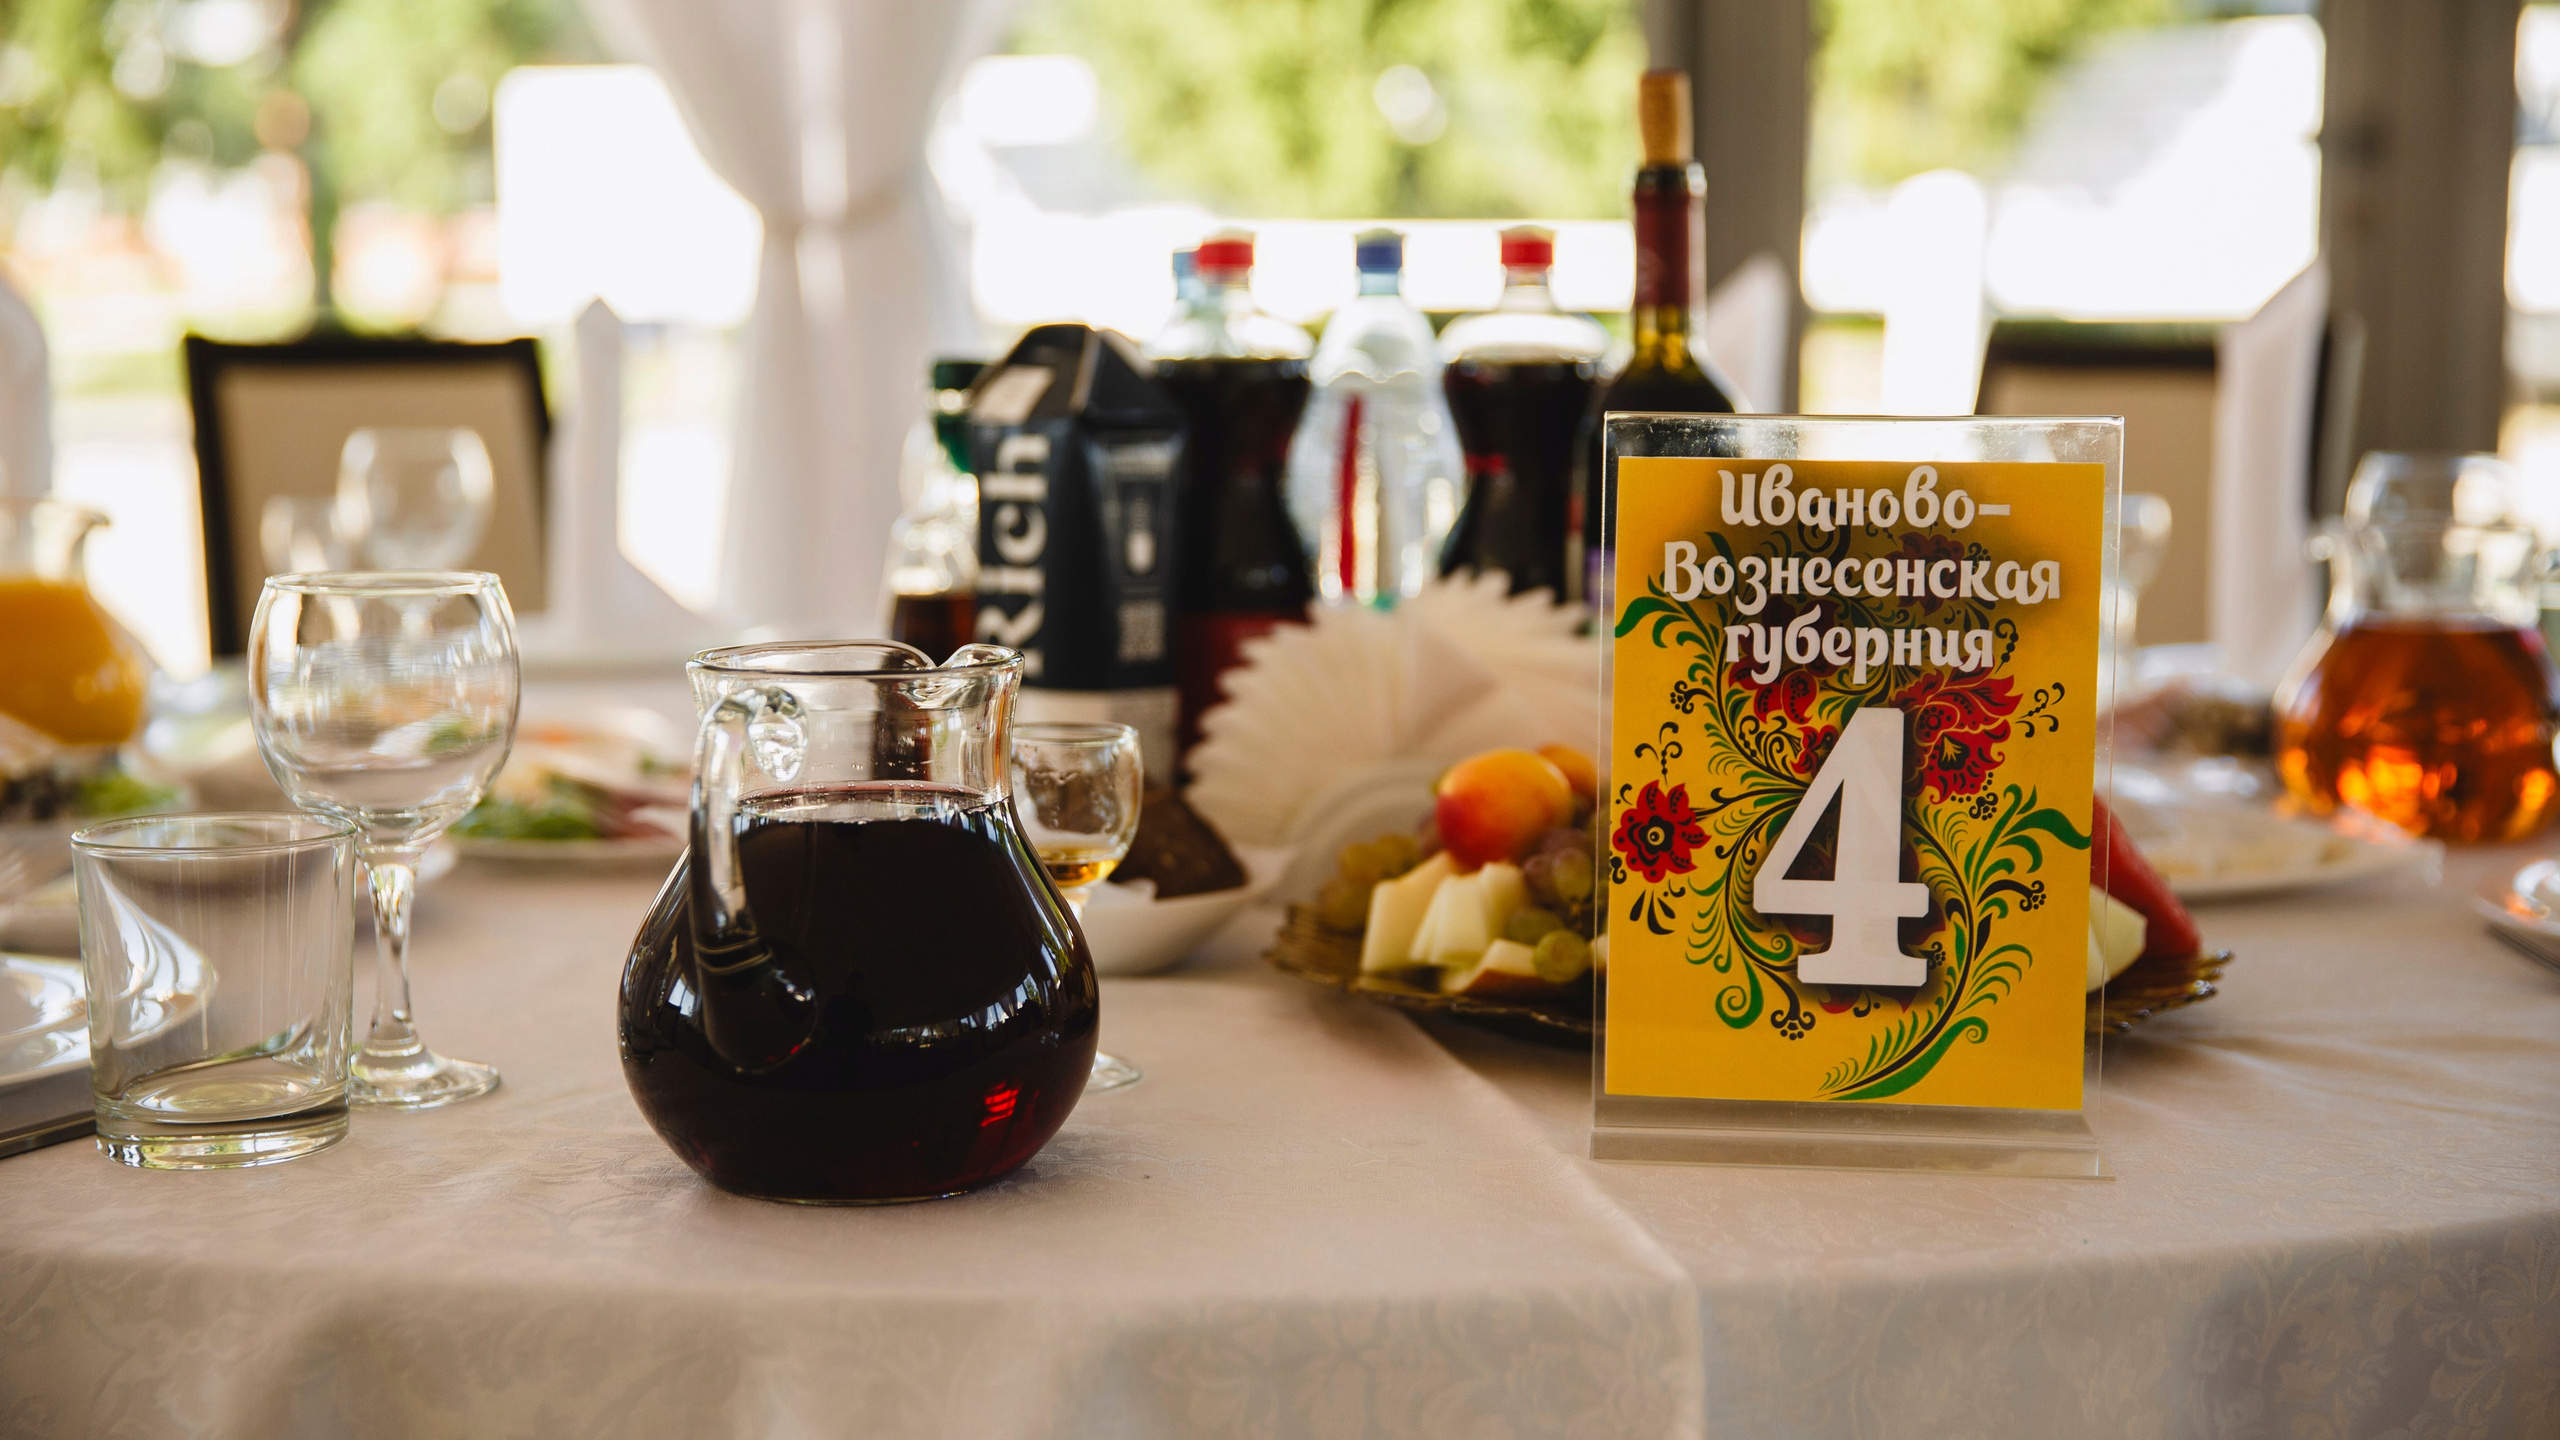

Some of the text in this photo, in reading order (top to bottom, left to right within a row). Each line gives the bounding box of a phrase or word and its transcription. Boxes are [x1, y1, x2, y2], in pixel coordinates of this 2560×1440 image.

[1718, 463, 2011, 532] Иваново-
[974, 433, 1050, 679] Rich
[1663, 541, 2061, 617] Вознесенская
[1724, 604, 1994, 685] губерния
[1753, 707, 1930, 987] 4
